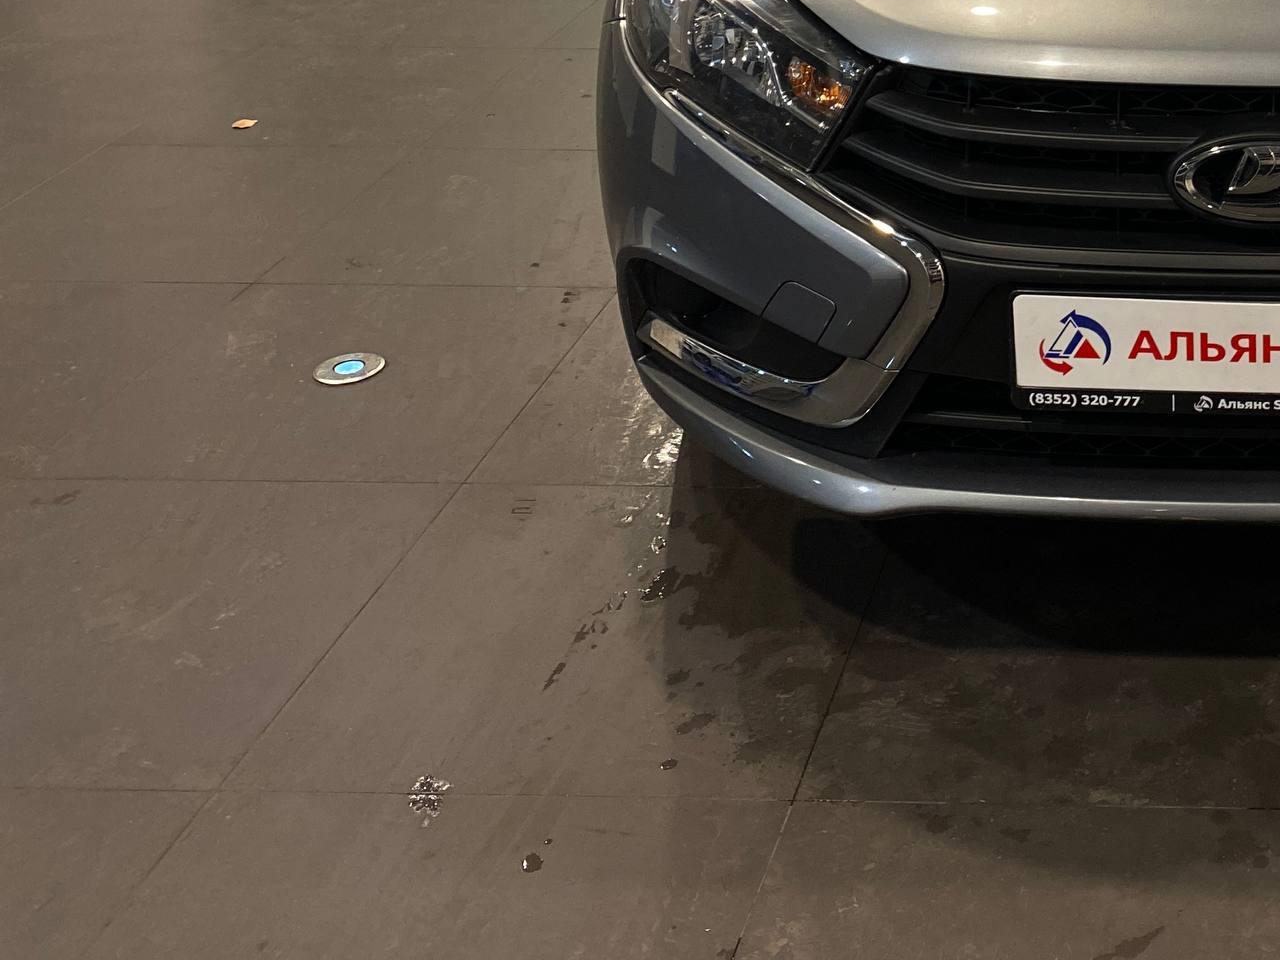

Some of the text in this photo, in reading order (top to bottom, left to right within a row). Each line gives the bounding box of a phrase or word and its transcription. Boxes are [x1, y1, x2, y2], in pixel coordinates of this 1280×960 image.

[1029, 392, 1140, 407] (8352) 320-777
[1217, 398, 1270, 411] Альянс
